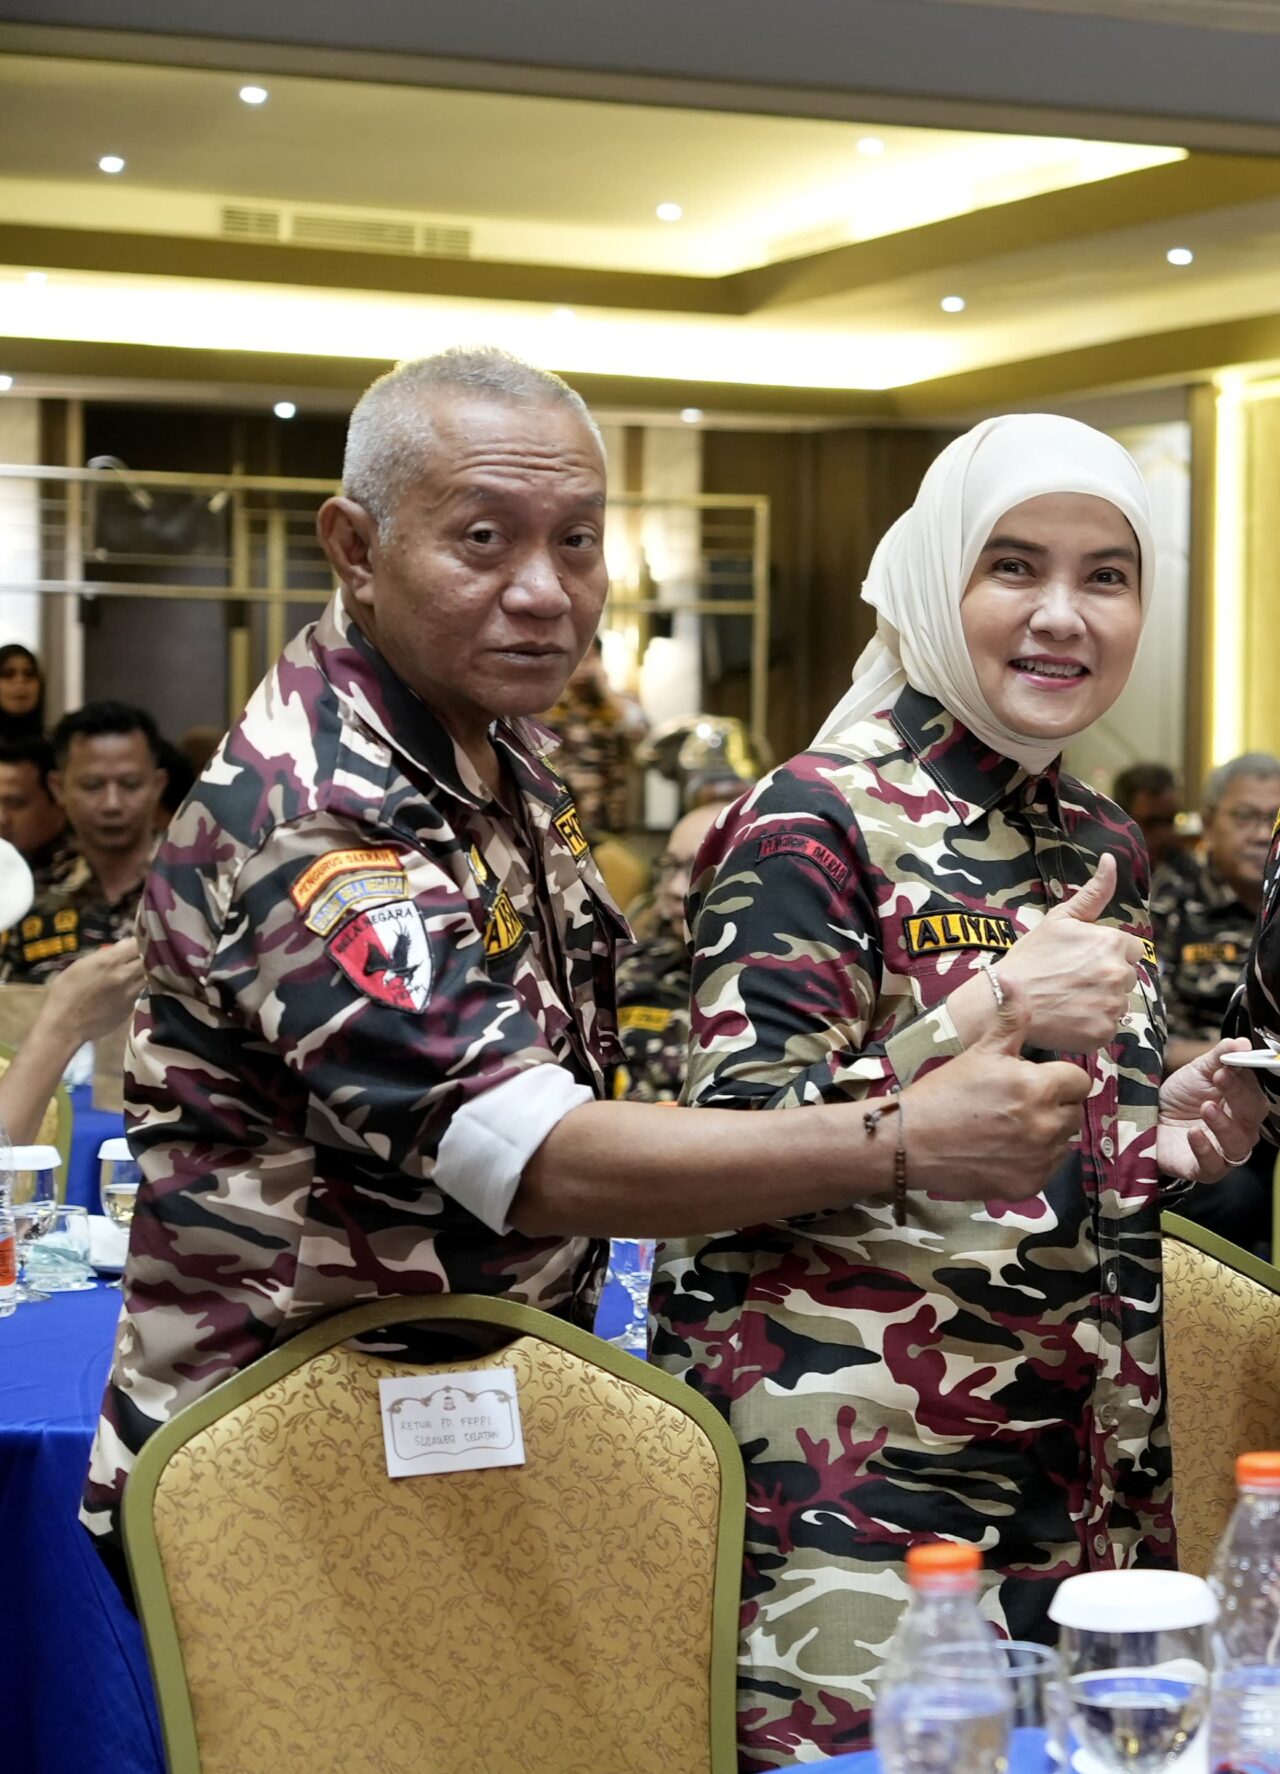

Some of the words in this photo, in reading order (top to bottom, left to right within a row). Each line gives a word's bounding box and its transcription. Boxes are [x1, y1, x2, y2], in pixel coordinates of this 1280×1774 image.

[365, 908, 413, 927] NEGARA
[917, 916, 1018, 948] ALIYAH
[400, 1421, 432, 1431] KETUA
[460, 1416, 492, 1427] FKPPI
